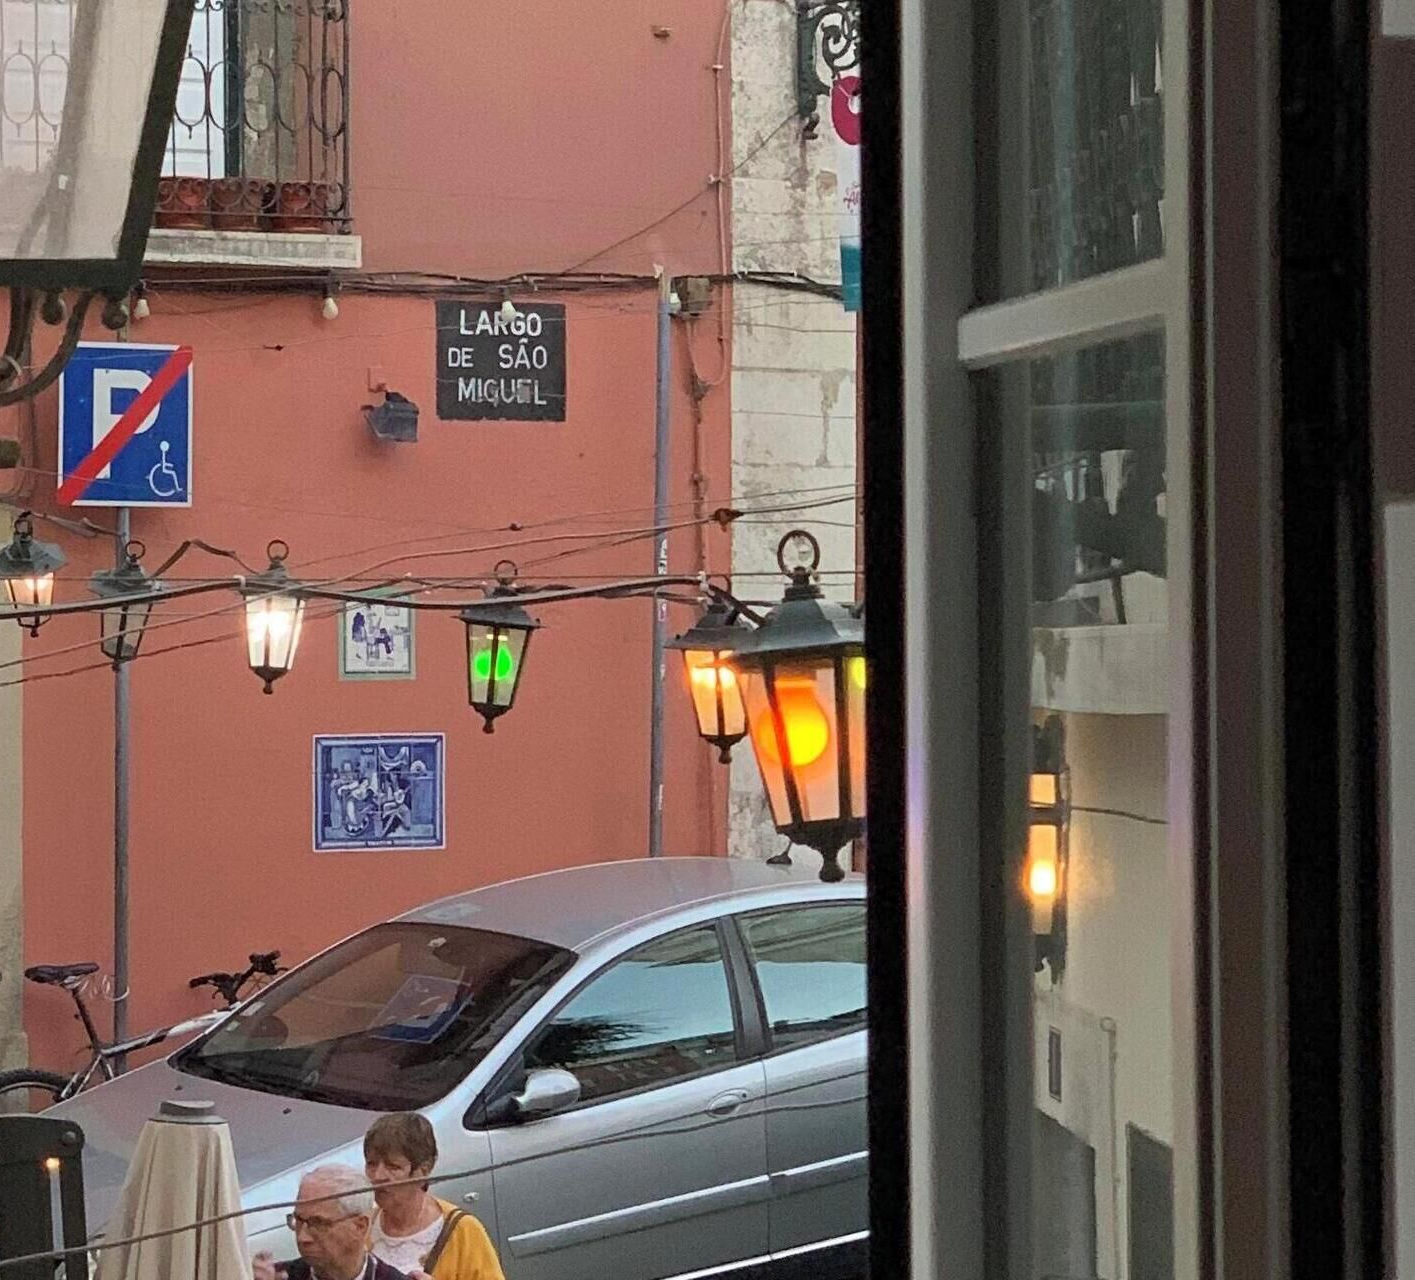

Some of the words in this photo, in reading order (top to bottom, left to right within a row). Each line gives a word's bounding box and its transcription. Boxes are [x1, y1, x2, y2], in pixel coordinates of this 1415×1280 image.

[459, 308, 543, 337] LARGO
[447, 347, 474, 368] DE
[498, 337, 548, 370] SÃO
[457, 376, 547, 406] MIGUEL
[92, 368, 162, 480] P
